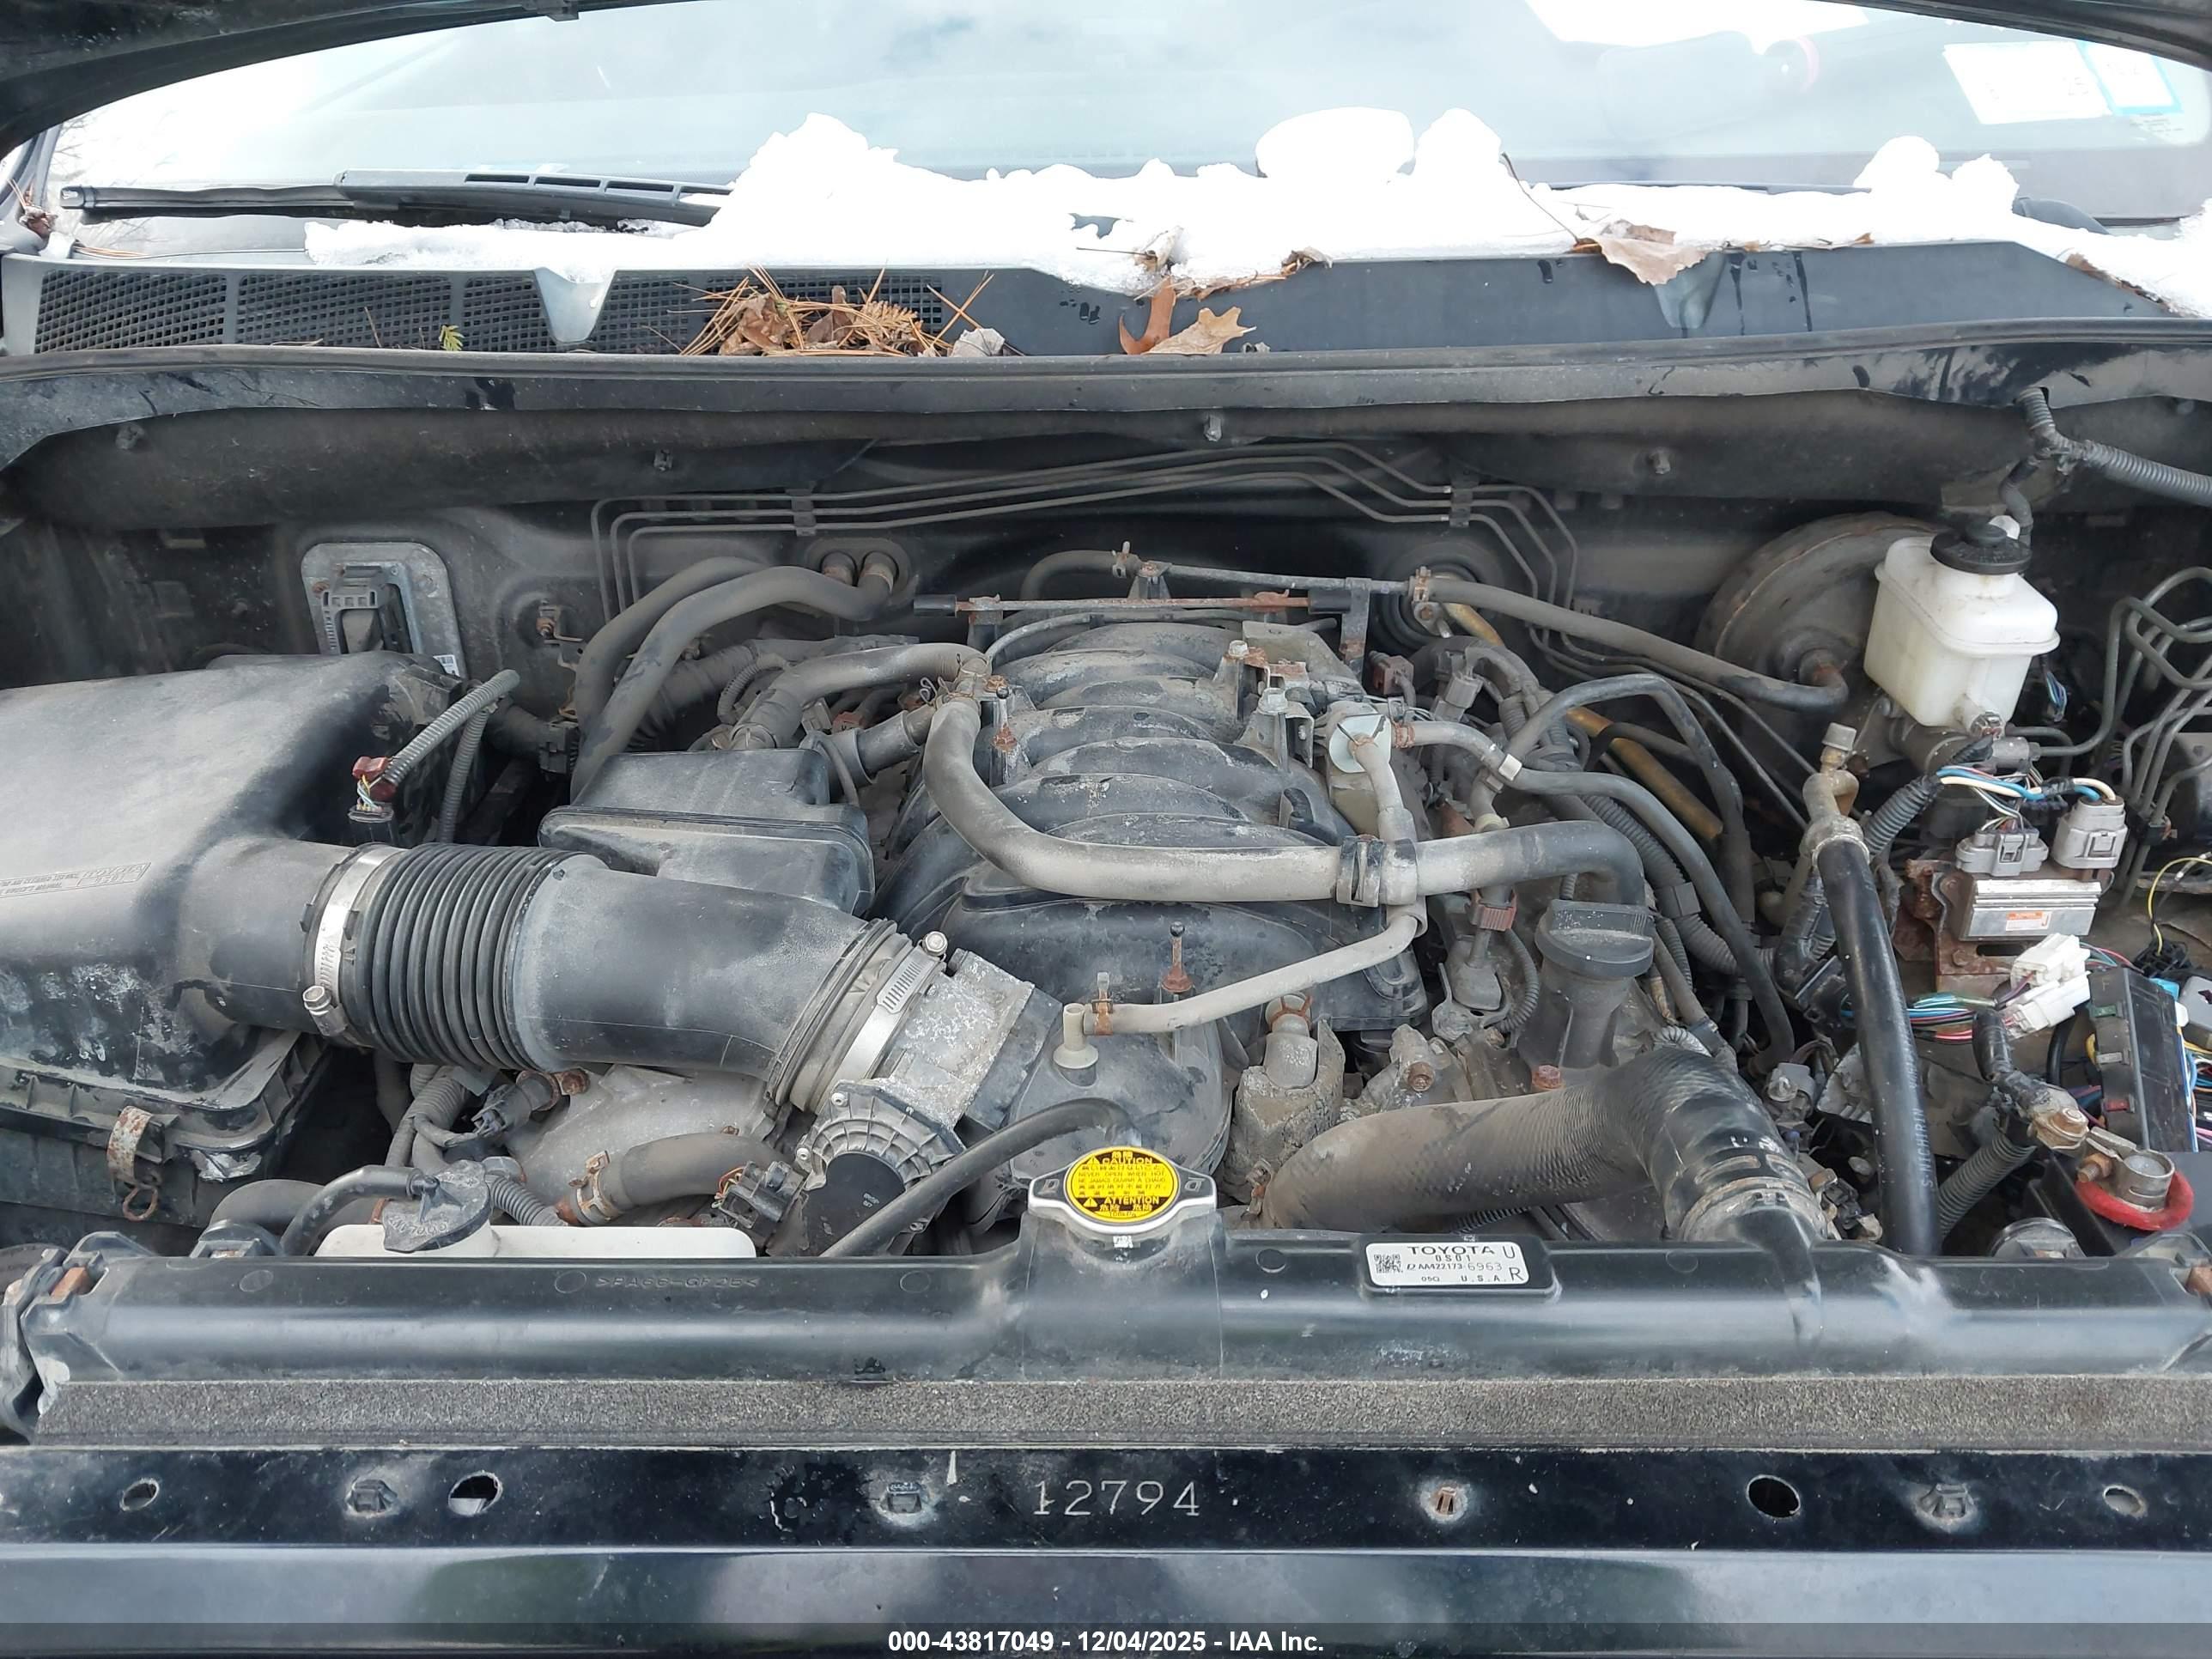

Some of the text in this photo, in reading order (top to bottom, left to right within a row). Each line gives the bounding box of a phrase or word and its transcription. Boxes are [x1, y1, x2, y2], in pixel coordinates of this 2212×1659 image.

[1104, 1196, 1159, 1205] ATTENTION
[1407, 1246, 1496, 1255] TOYOTA
[1503, 1246, 1516, 1259] U
[1509, 1267, 1524, 1281] R
[1033, 1480, 1200, 1516] 12794
